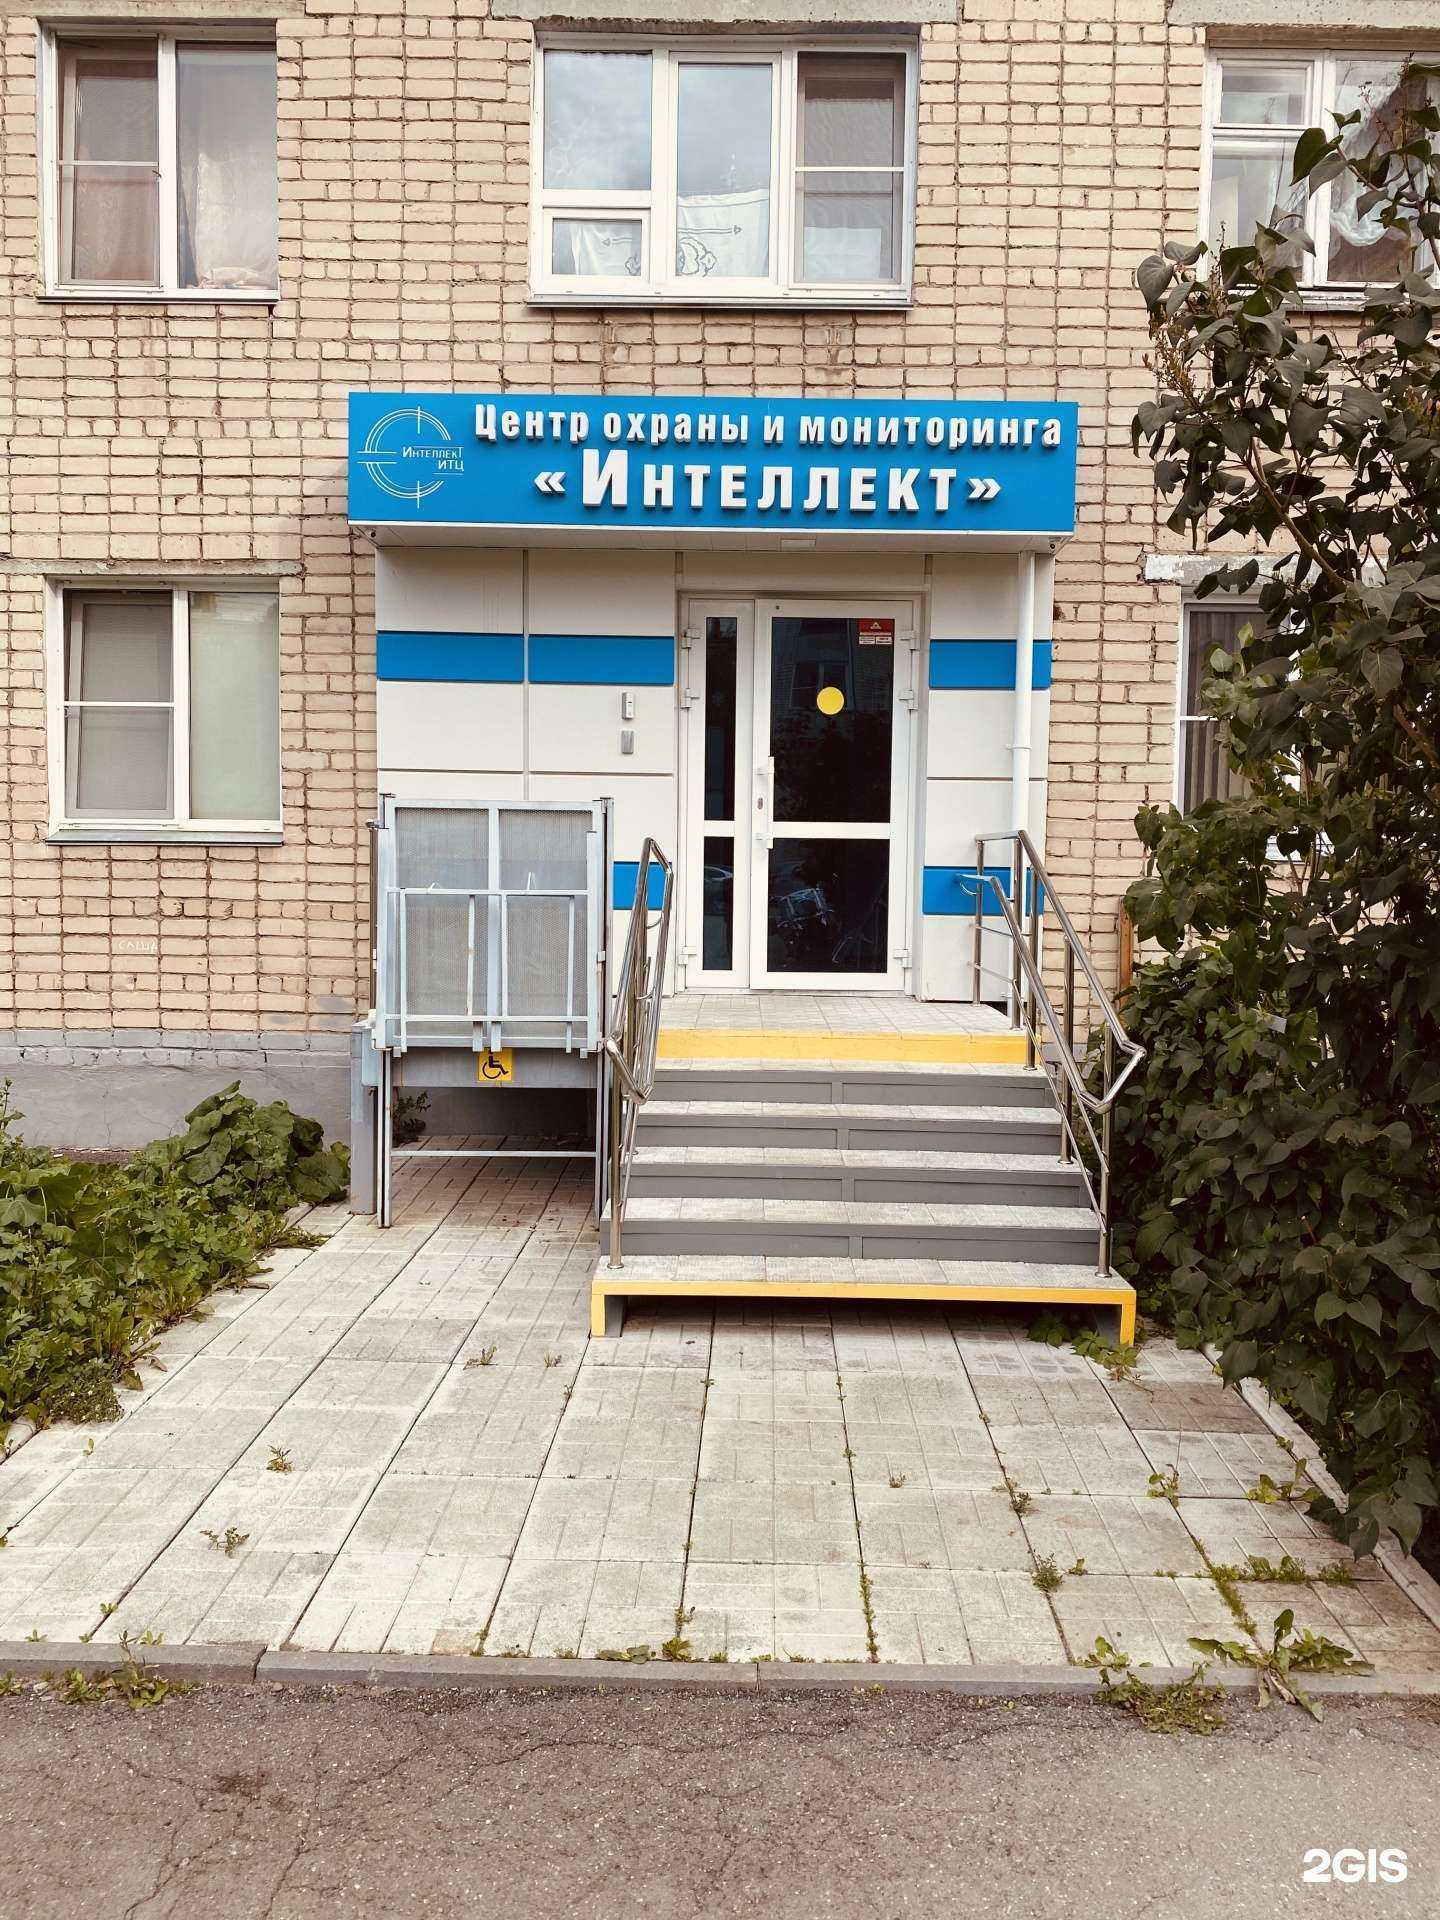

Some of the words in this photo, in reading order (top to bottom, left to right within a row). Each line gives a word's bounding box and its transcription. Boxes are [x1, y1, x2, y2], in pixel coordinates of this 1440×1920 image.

[475, 404, 590, 444] Центр
[603, 410, 749, 446] охраны
[763, 415, 785, 444] и
[800, 415, 1062, 449] мониторинга
[438, 459, 465, 472] ИТЦ
